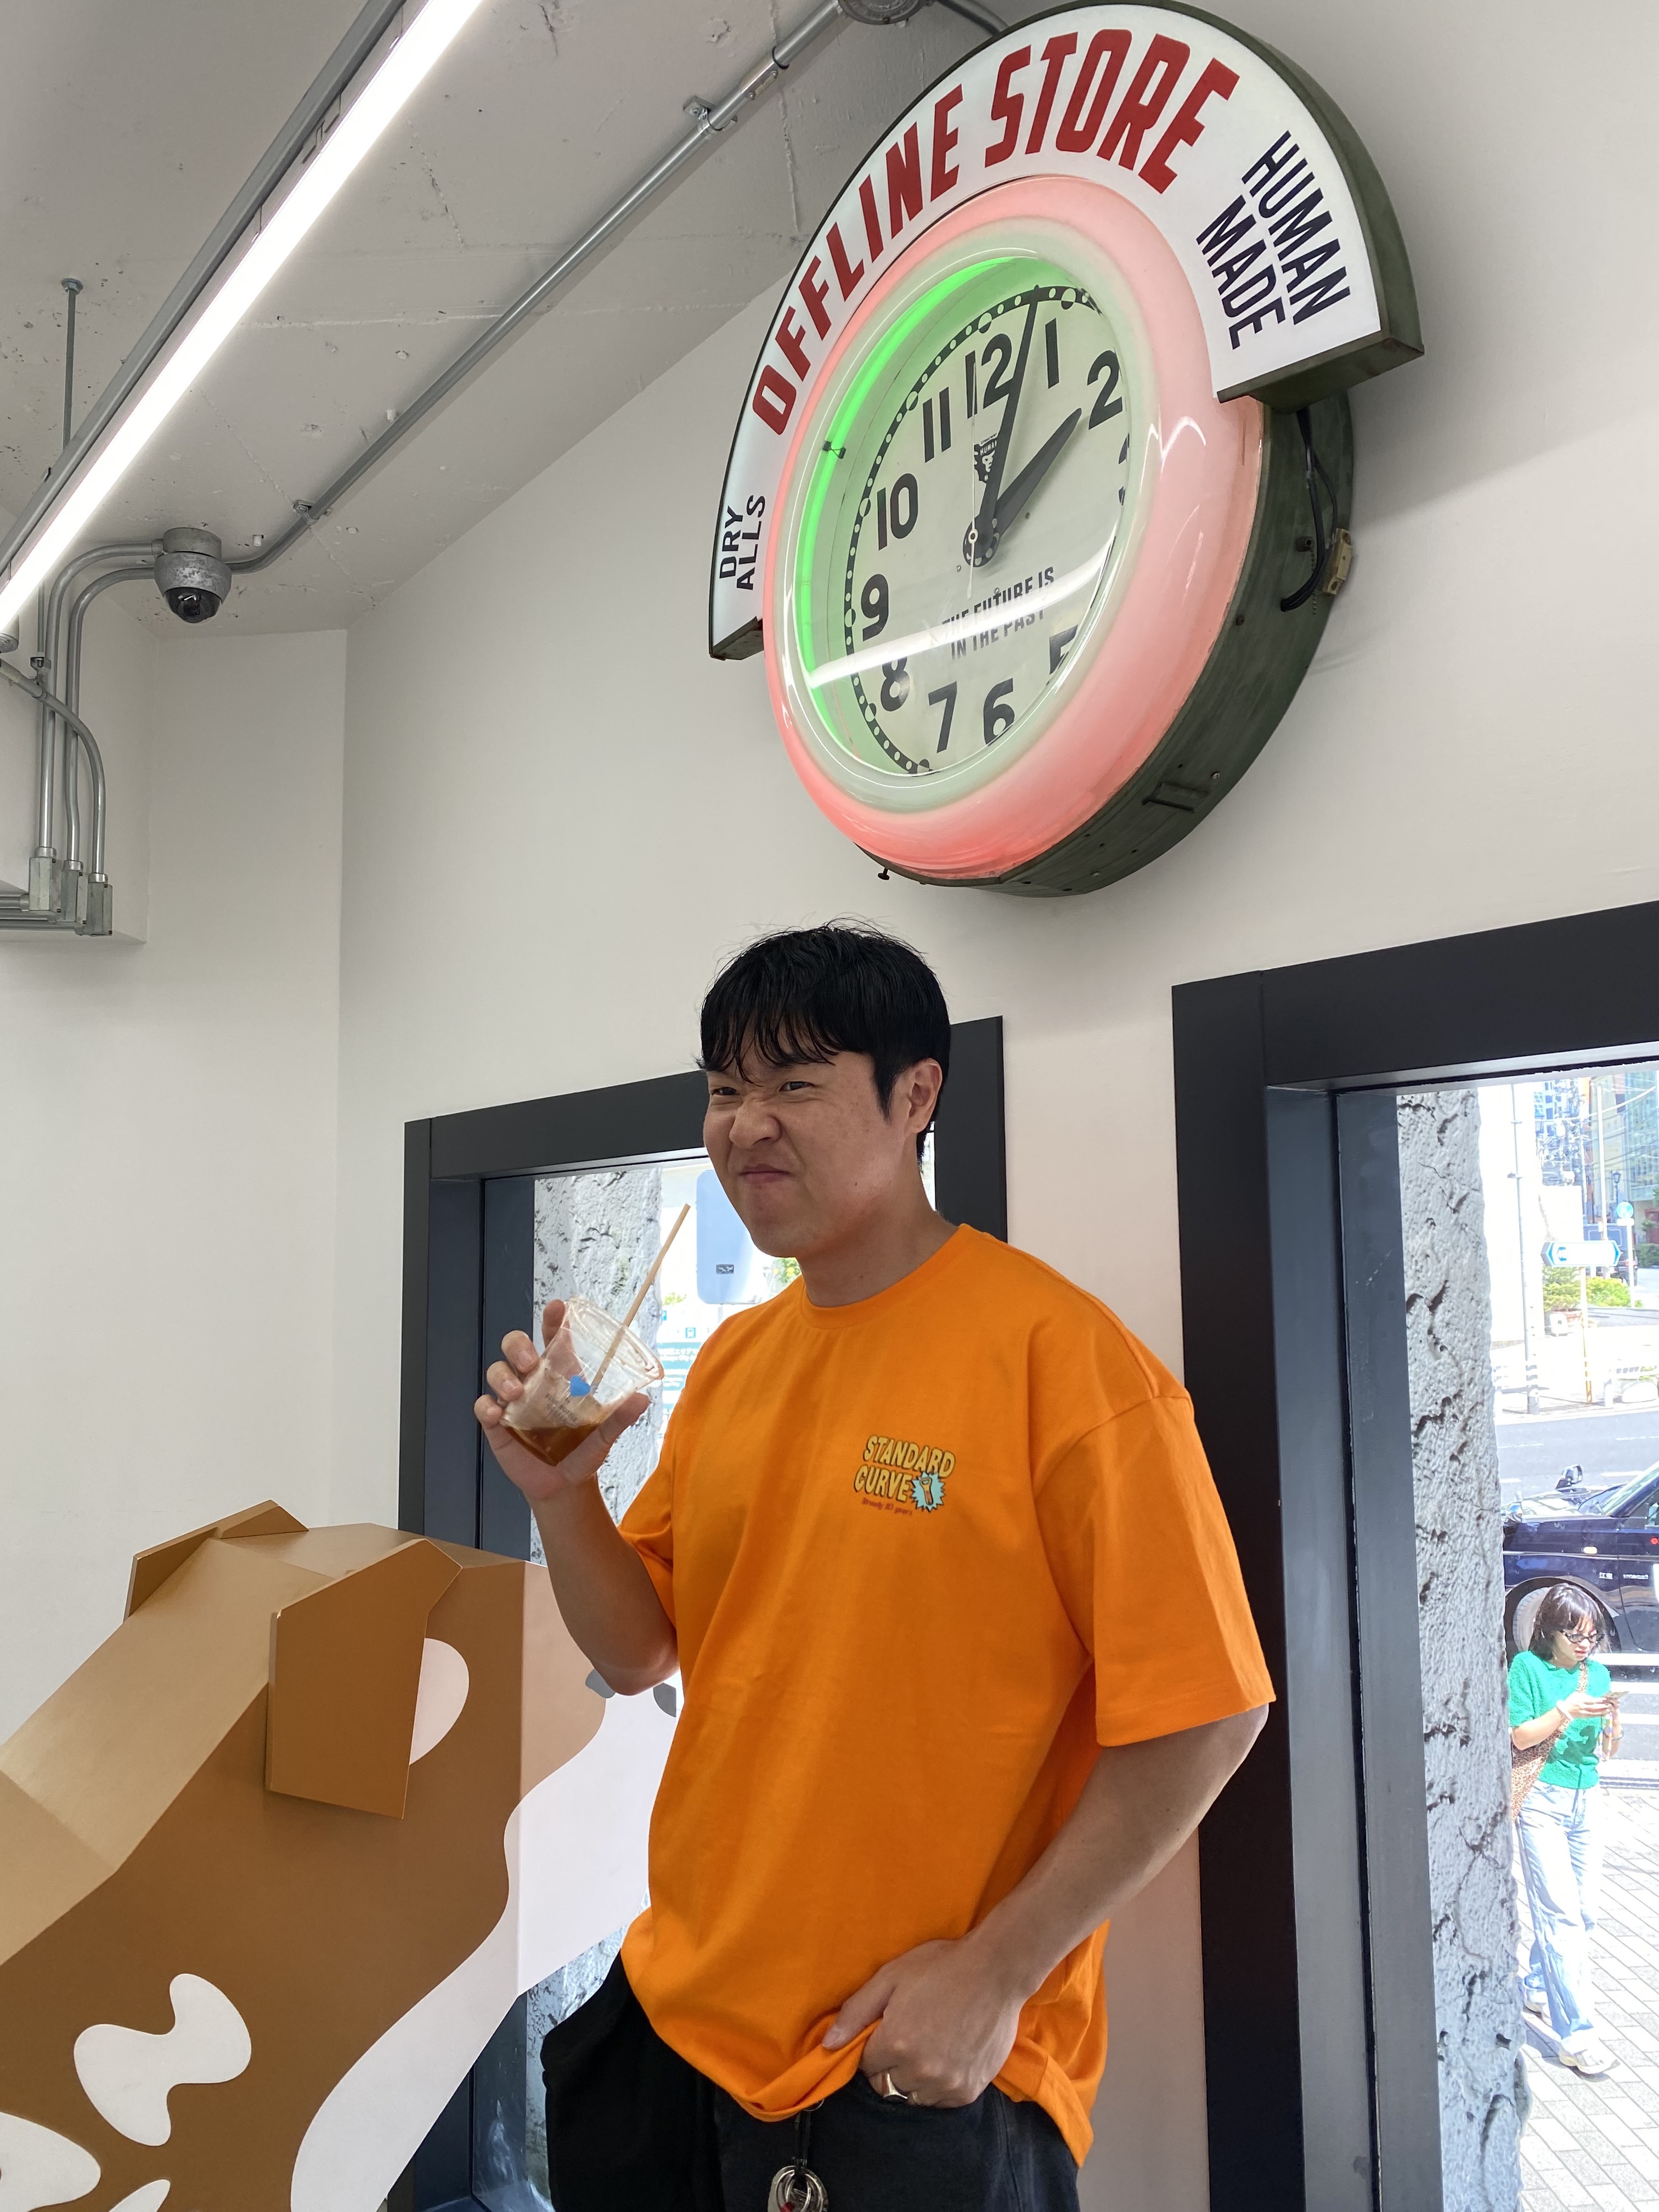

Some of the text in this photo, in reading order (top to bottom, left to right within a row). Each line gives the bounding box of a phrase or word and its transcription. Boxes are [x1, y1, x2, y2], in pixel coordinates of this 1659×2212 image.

[752, 29, 1240, 436] OFFLINE STORE
[1241, 129, 1351, 325] HUMAN
[1195, 194, 1286, 351] MADE
[964, 333, 1015, 419] 12
[1045, 317, 1059, 389] 1
[1086, 349, 1123, 430] 2
[922, 386, 951, 463] 11
[719, 505, 744, 579] DRY
[736, 495, 766, 591] ALLS
[877, 473, 918, 551] 10
[860, 573, 889, 642] 9
[1038, 566, 1054, 589] IS
[880, 653, 911, 712] 8
[951, 637, 967, 661] IN
[928, 681, 958, 754] 7
[983, 678, 1015, 747] 6
[854, 1463, 913, 1503] CURVE
[862, 1434, 956, 1479] STANDARD
